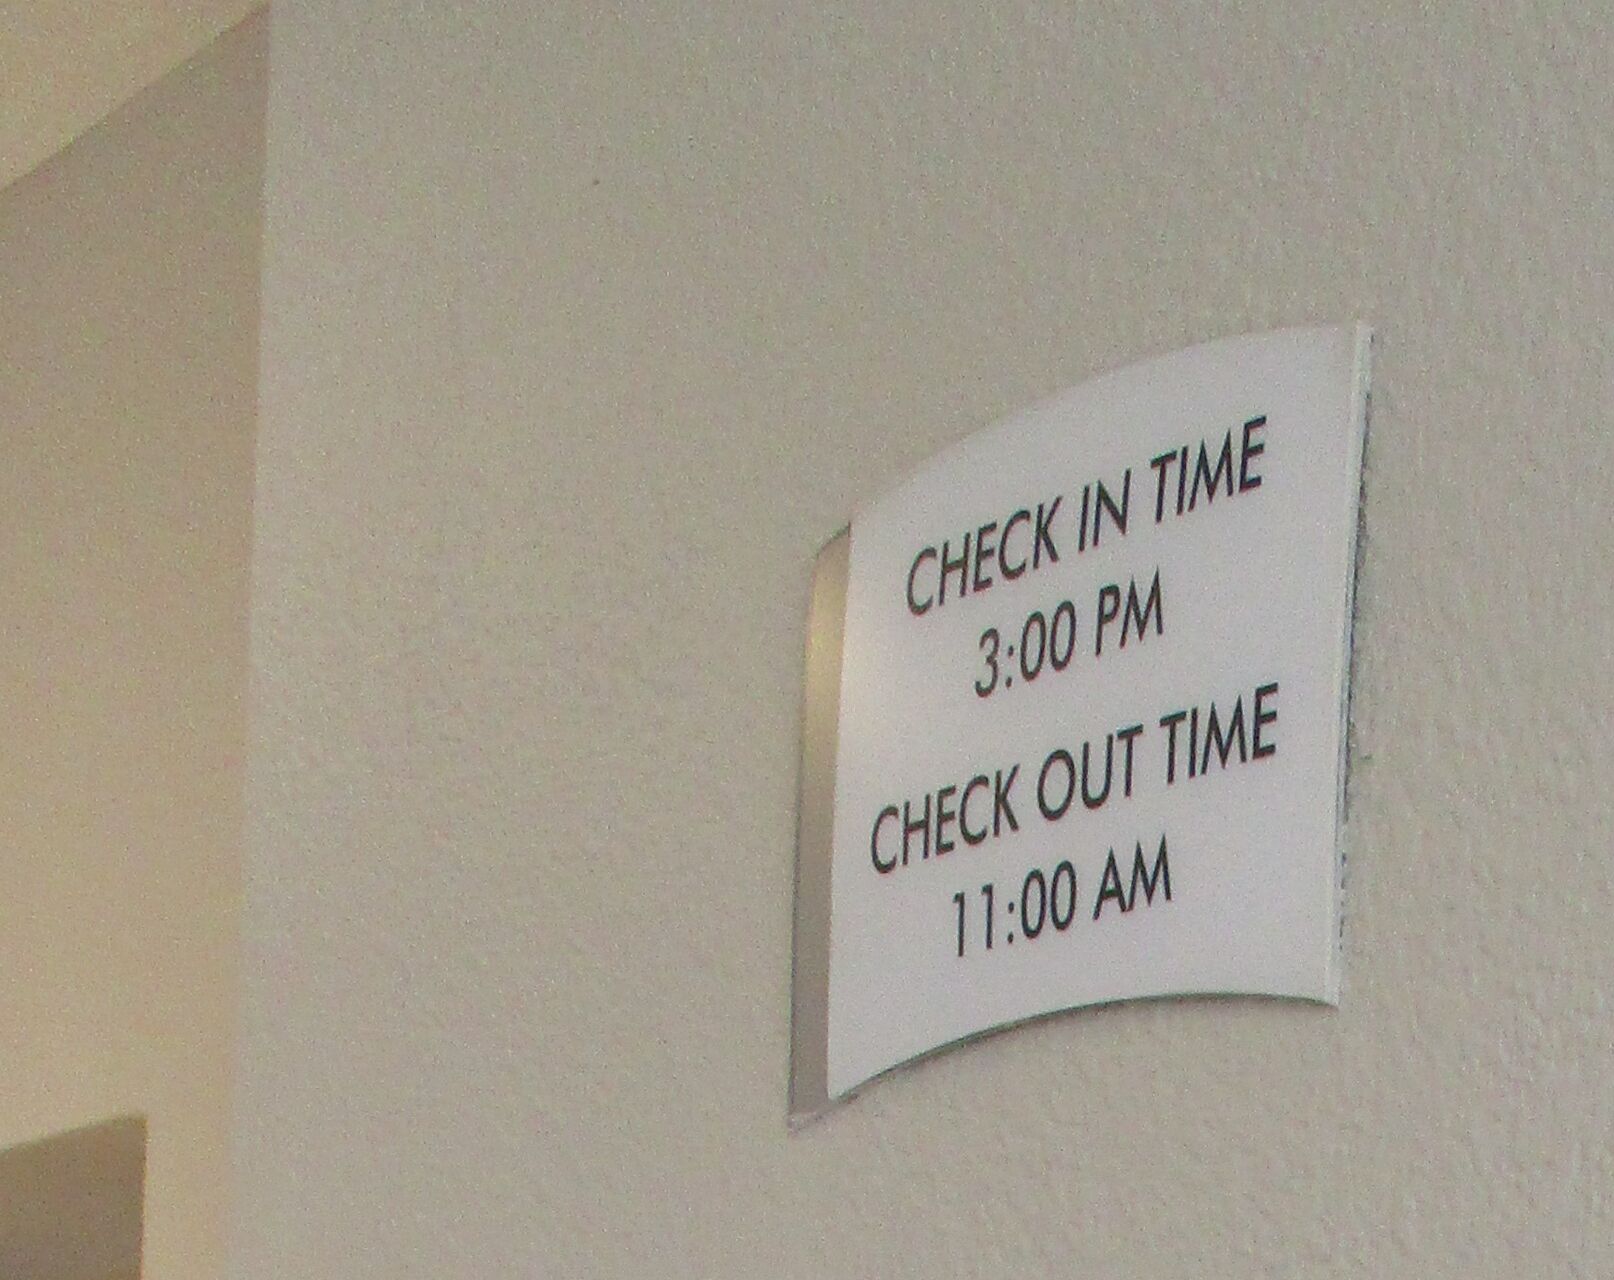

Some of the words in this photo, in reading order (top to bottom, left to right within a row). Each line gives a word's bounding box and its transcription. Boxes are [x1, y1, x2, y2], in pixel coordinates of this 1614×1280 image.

[906, 495, 1061, 615] CHECK
[1078, 469, 1131, 552] IN
[1150, 416, 1267, 522] TIME
[974, 601, 1077, 698] 3:00
[1095, 567, 1164, 656] PM
[870, 765, 1020, 874] CHECK
[1037, 726, 1144, 822] OUT
[1160, 682, 1279, 784] TIME
[952, 859, 1078, 957] 11:00
[1094, 835, 1172, 921] AM
